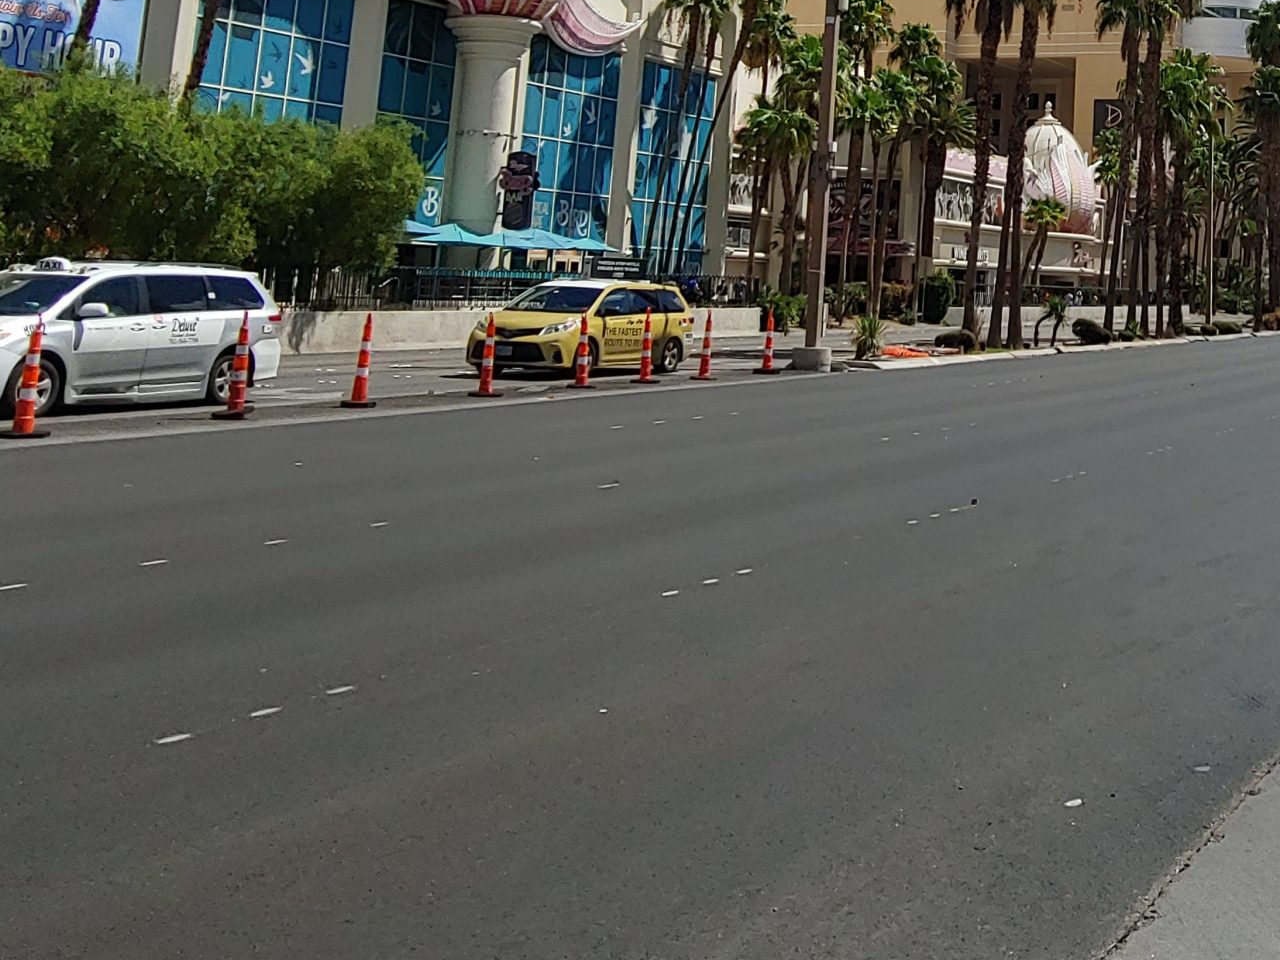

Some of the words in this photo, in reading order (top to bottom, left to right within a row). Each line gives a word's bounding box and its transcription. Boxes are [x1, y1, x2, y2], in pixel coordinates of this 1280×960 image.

[39, 260, 61, 270] TAXI
[606, 327, 617, 336] THE
[618, 327, 642, 336] FASTEST
